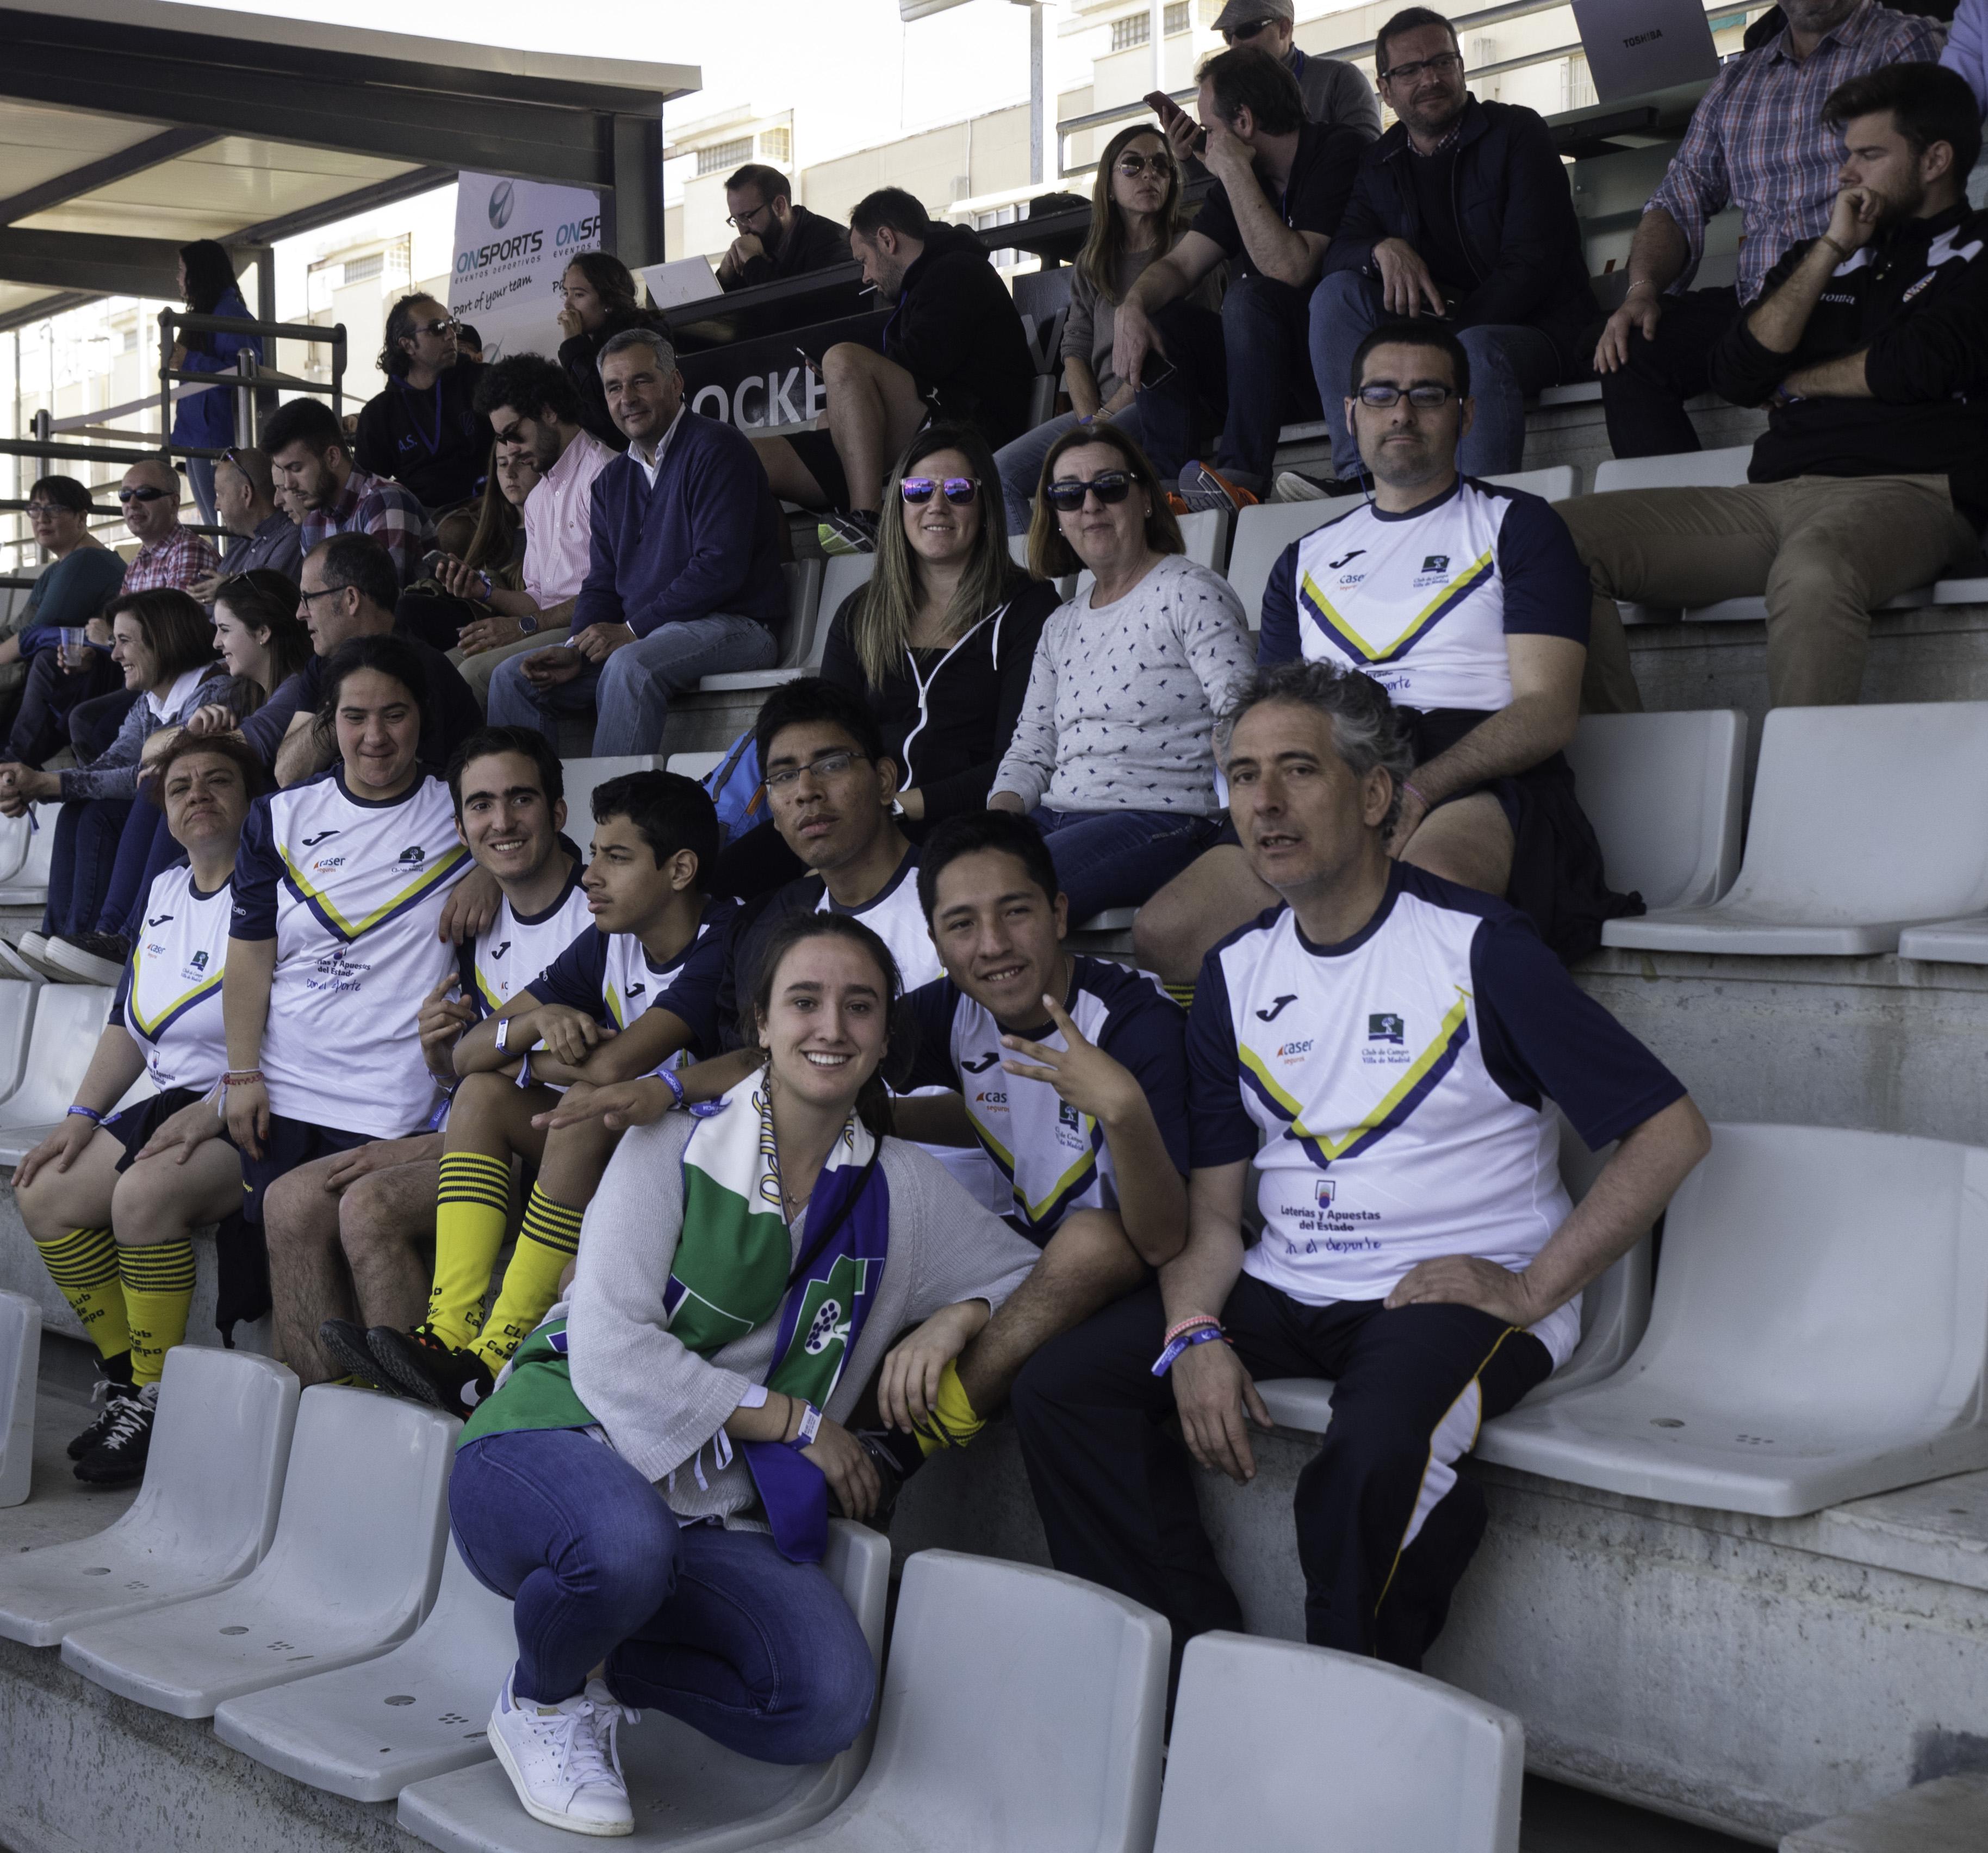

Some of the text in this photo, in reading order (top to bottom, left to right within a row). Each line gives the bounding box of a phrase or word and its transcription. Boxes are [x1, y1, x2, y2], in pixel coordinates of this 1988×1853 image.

[1623, 29, 1663, 48] TOSHIBA
[456, 229, 543, 273] ONSPORTS
[455, 255, 541, 284] EVENTOS DEPORTIVOS
[474, 290, 484, 310] of
[485, 285, 507, 309] your
[509, 275, 532, 291] team
[399, 434, 418, 453] A.S.
[1284, 1039, 1314, 1055] caser
[1387, 1048, 1409, 1056] Campo
[1318, 1211, 1325, 1221] y
[1327, 1210, 1381, 1221] Apuestas
[1299, 1220, 1355, 1232] del Estado
[1306, 1238, 1318, 1254] el
